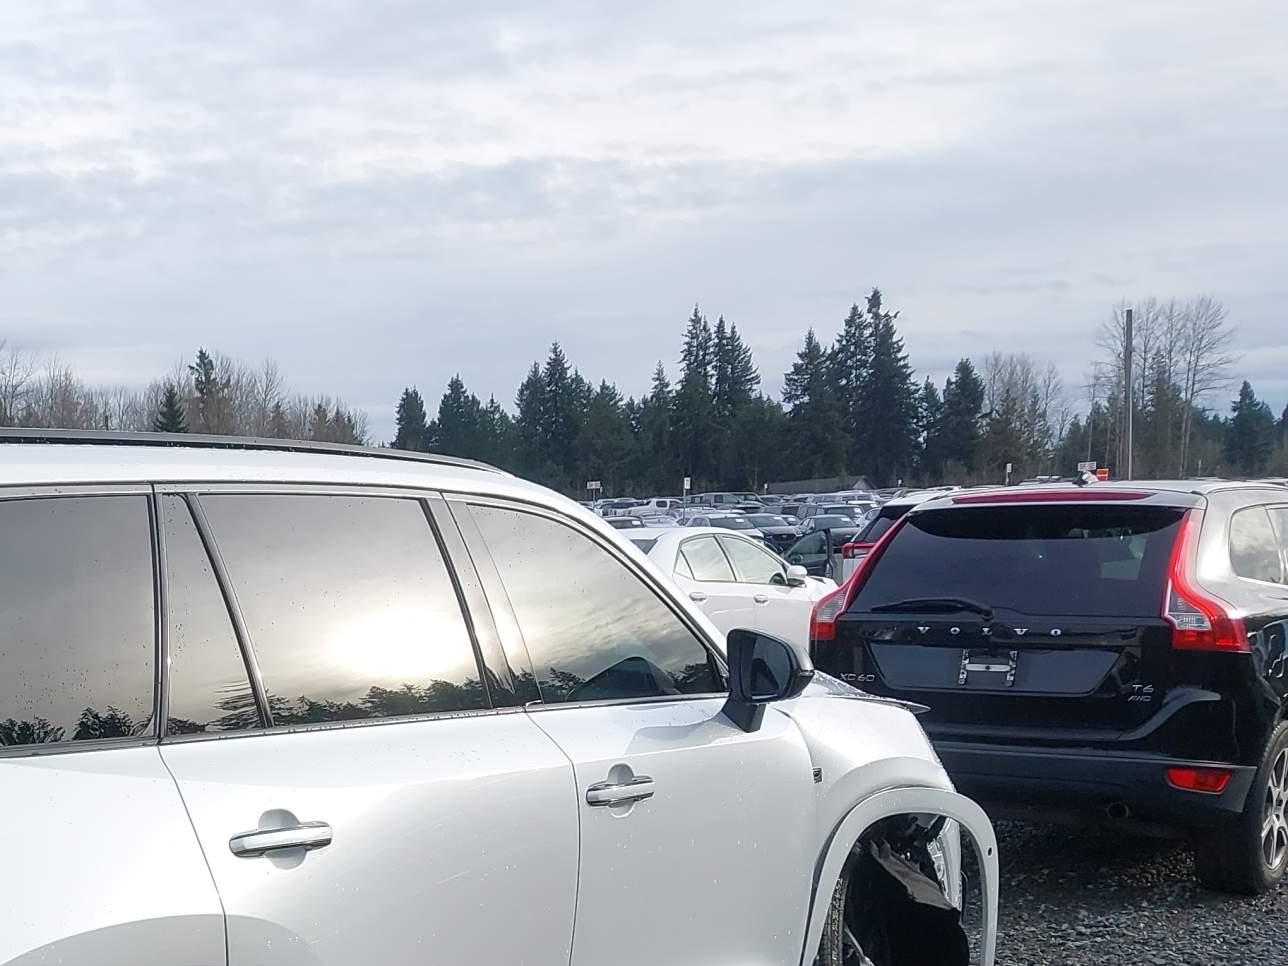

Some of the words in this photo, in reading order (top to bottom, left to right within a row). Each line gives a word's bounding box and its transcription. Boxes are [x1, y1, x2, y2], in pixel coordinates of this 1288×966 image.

[916, 626, 1062, 637] VOLVO
[839, 672, 876, 682] XC60
[1132, 684, 1154, 693] T6
